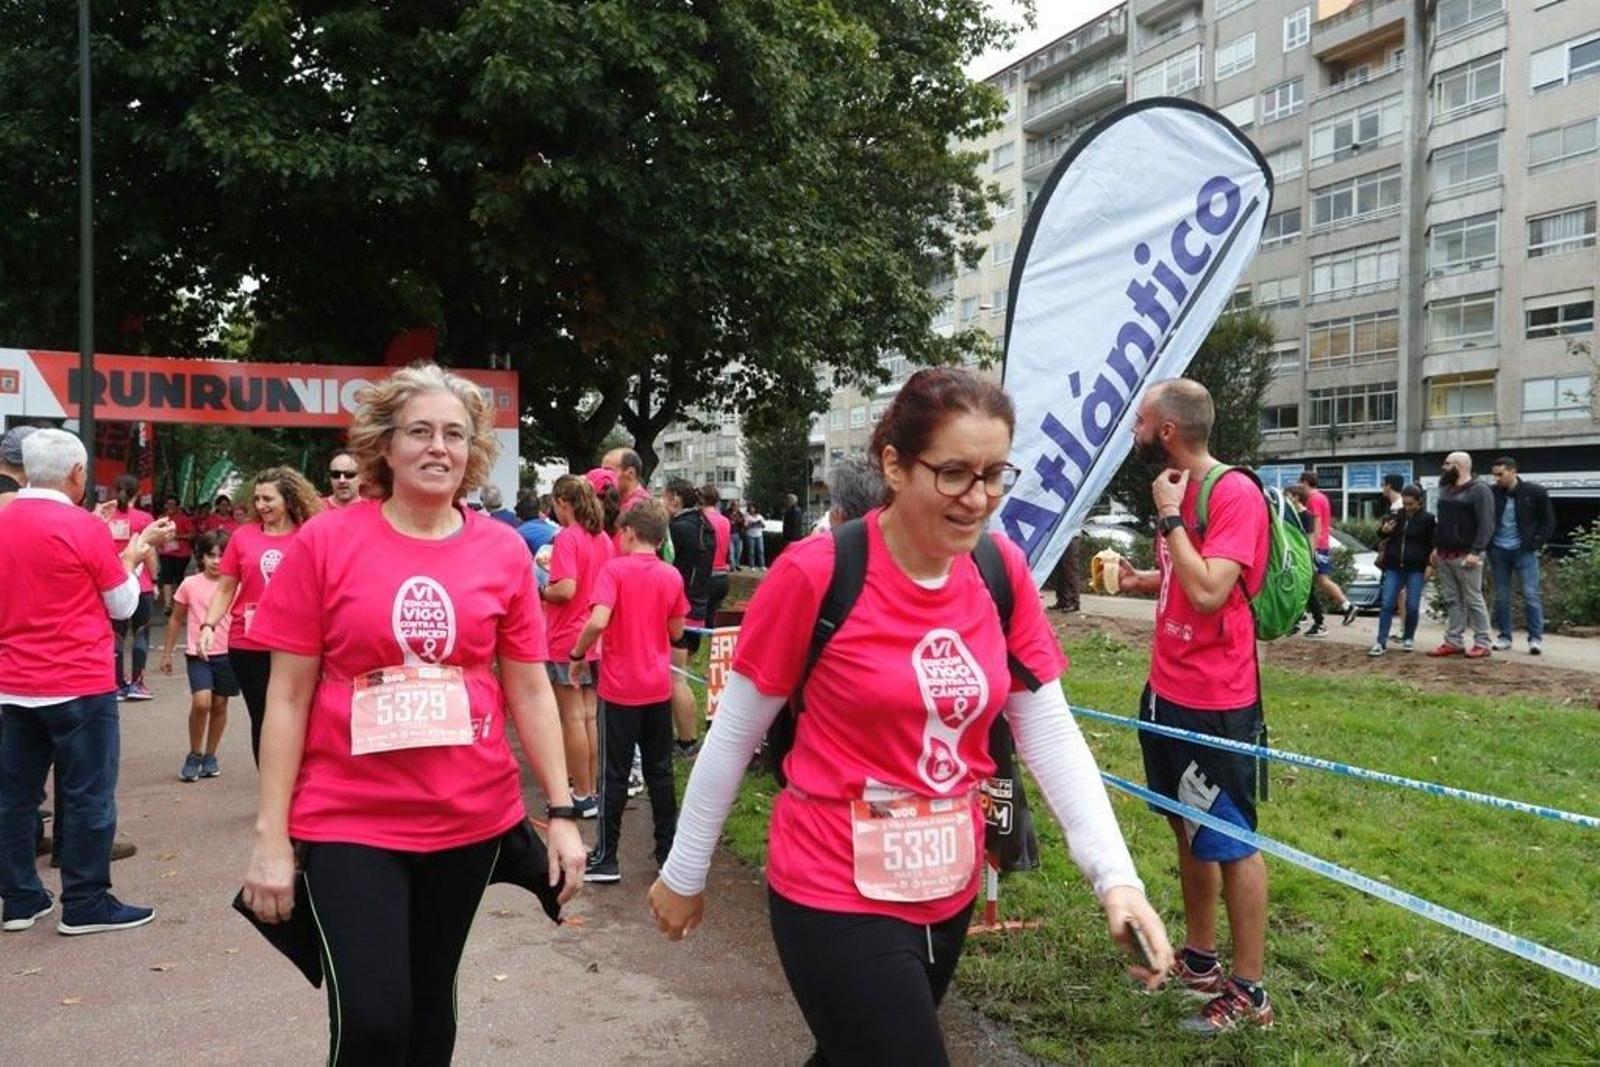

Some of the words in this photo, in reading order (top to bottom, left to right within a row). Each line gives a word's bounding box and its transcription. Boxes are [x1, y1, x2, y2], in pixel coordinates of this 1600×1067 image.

[1000, 174, 1242, 563] Atlántico
[411, 584, 433, 600] VI
[402, 608, 446, 621] VIGO
[924, 665, 971, 680] VIGO
[376, 689, 448, 726] 5329
[883, 826, 957, 871] 5330
